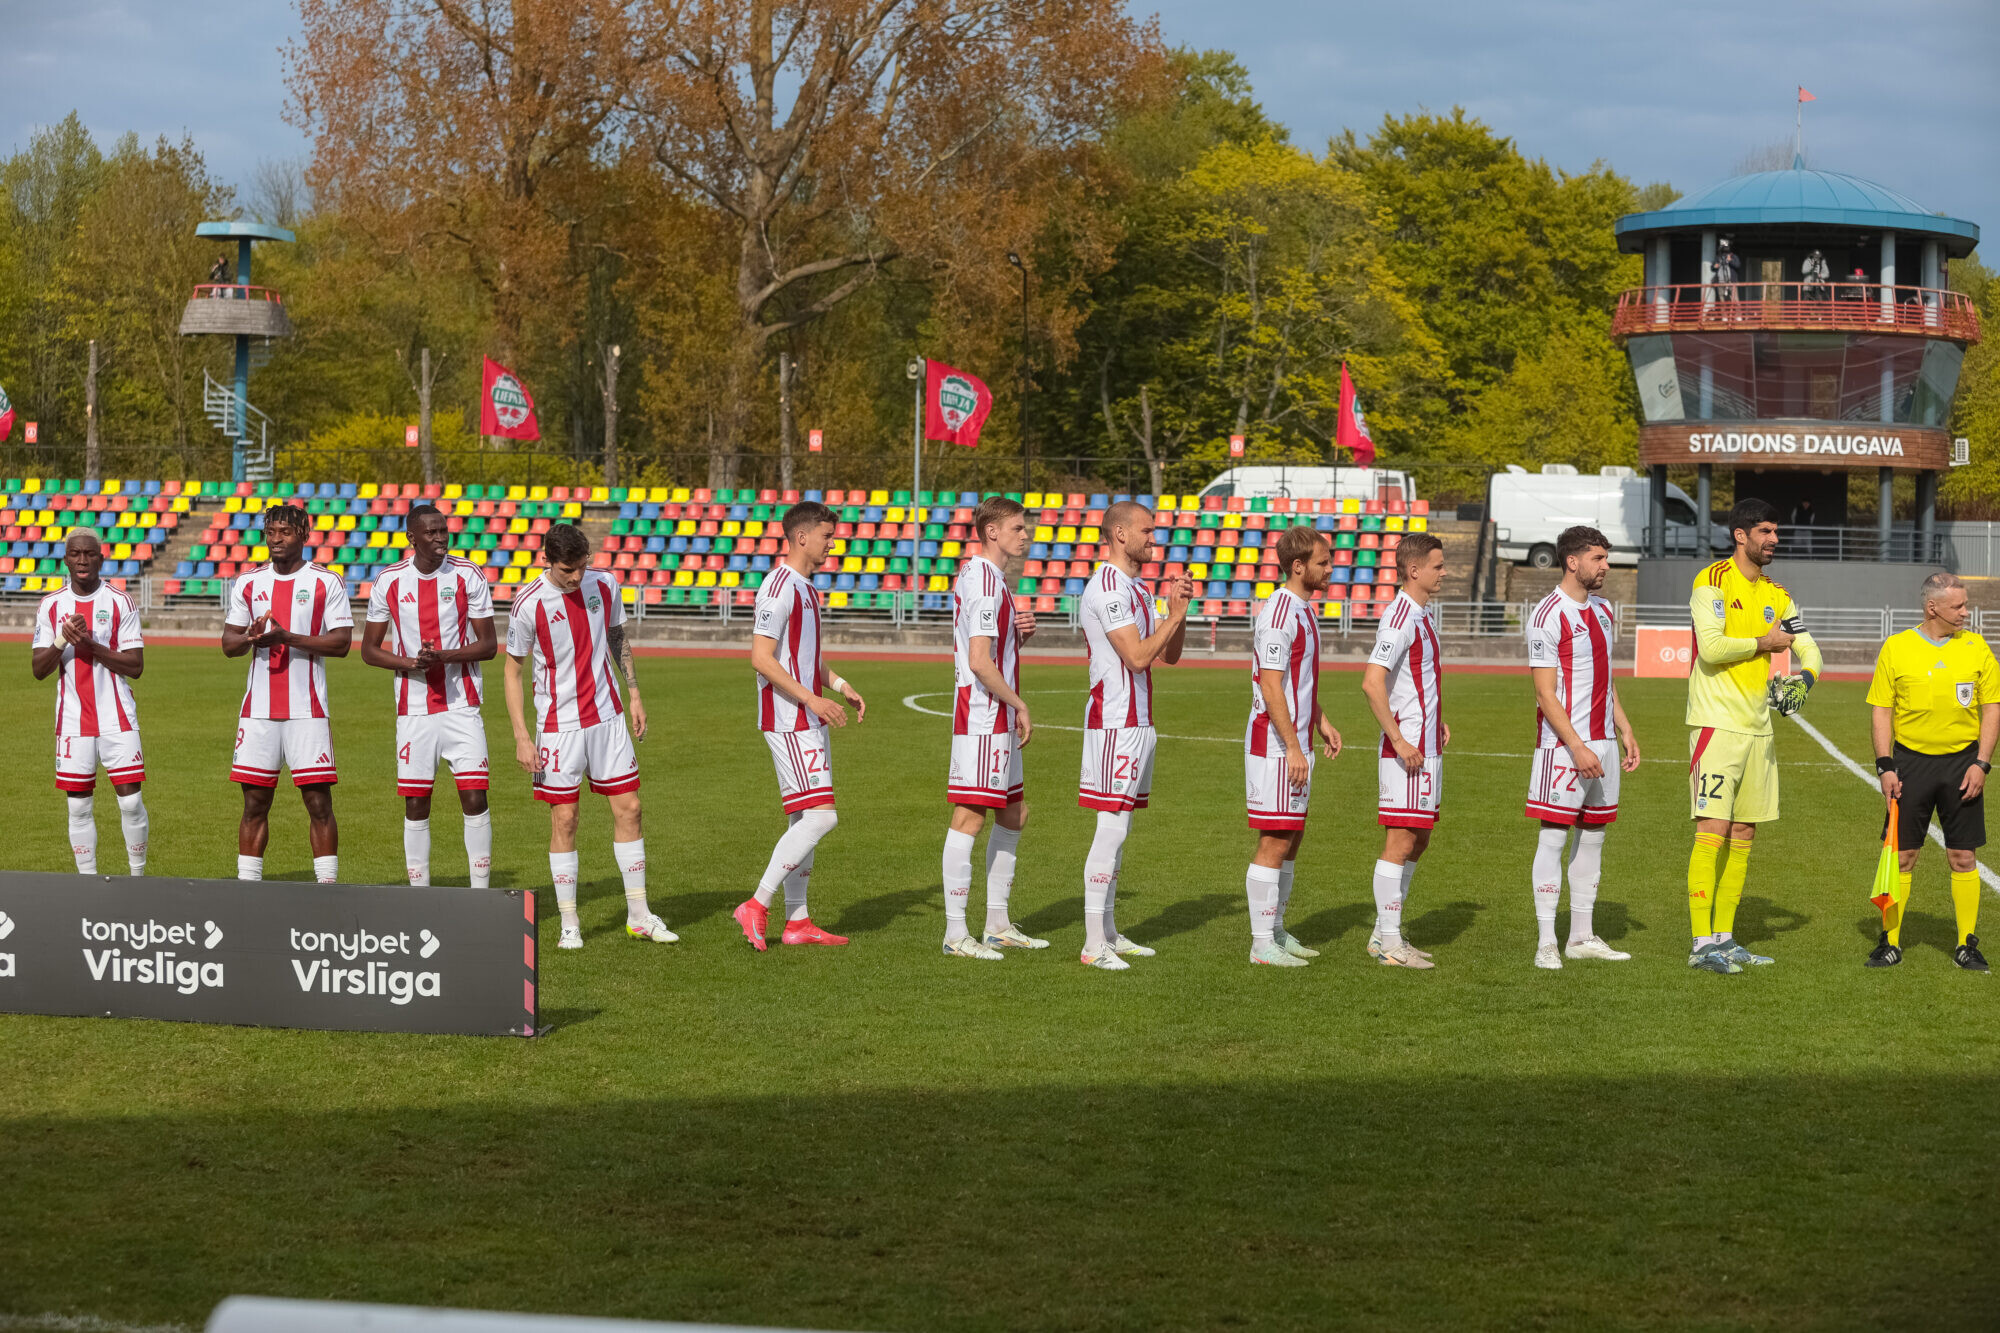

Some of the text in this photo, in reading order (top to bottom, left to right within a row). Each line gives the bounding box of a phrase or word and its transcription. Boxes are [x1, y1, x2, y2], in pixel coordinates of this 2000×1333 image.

[1689, 433, 1904, 456] STADIONS DAUGAVA
[56, 735, 72, 758] 11
[399, 742, 411, 765] 4
[992, 749, 1009, 774] 17
[1115, 755, 1138, 781] 26
[1552, 765, 1579, 792] 72
[1699, 773, 1725, 800] 12
[82, 918, 196, 950] tonybet
[291, 928, 410, 960] tonybet
[82, 948, 224, 994] Virslīga
[291, 959, 440, 1005] Virslīga
